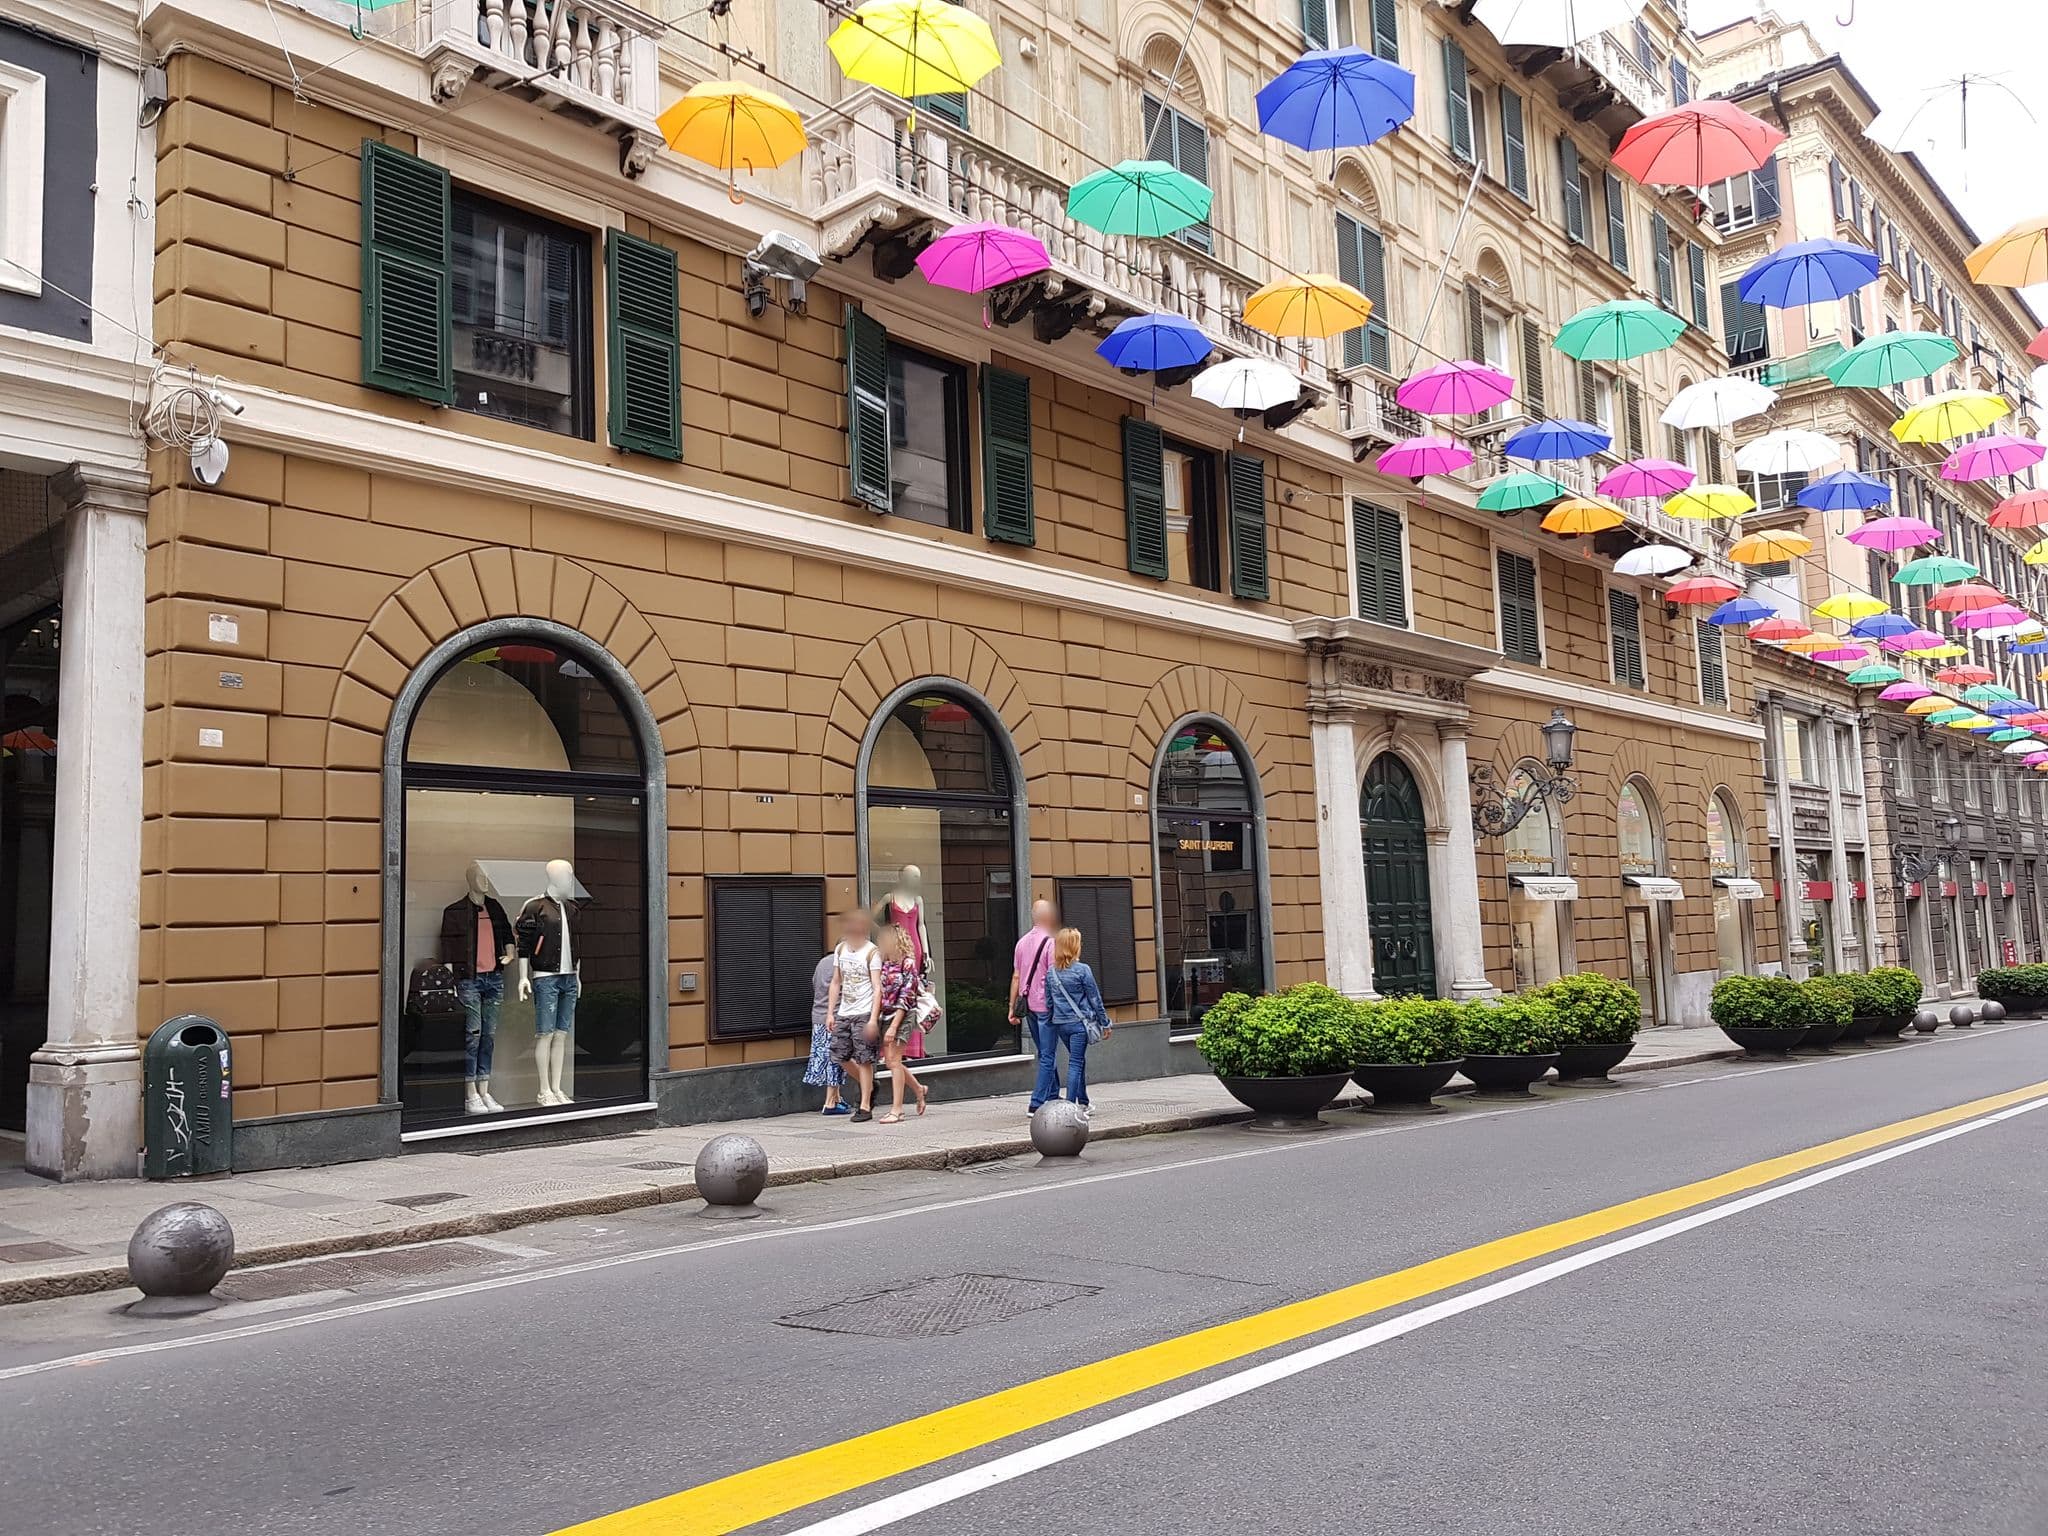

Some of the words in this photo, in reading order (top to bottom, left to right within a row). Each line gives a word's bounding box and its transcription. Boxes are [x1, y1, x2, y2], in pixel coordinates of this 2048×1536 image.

[1179, 839, 1200, 850] SAINT
[1202, 840, 1234, 851] LAURENT
[198, 1056, 208, 1099] GENOVA
[196, 1104, 210, 1145] AMIU
